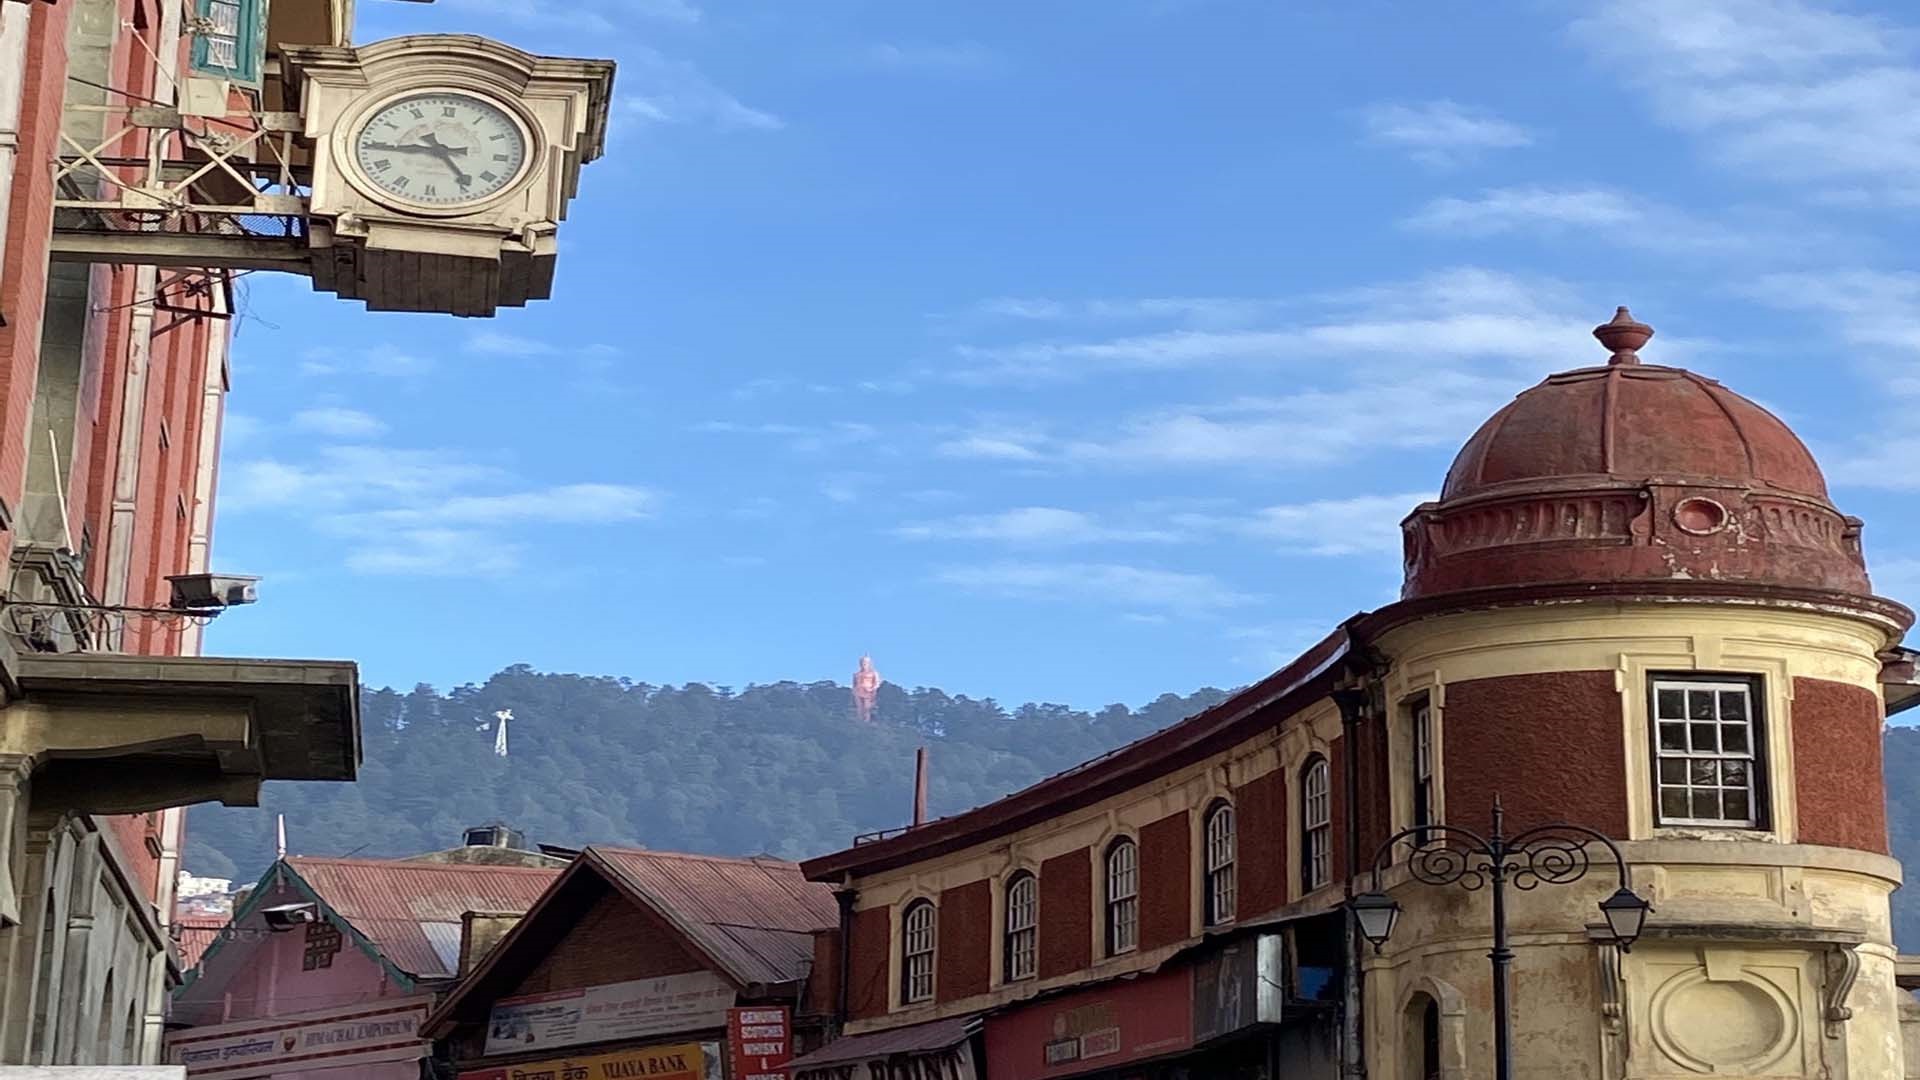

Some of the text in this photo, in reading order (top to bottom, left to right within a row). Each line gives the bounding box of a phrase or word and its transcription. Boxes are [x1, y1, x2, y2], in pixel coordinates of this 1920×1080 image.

[305, 1026, 354, 1047] HIMACHAL
[601, 1054, 688, 1077] VIJAYA BANK
